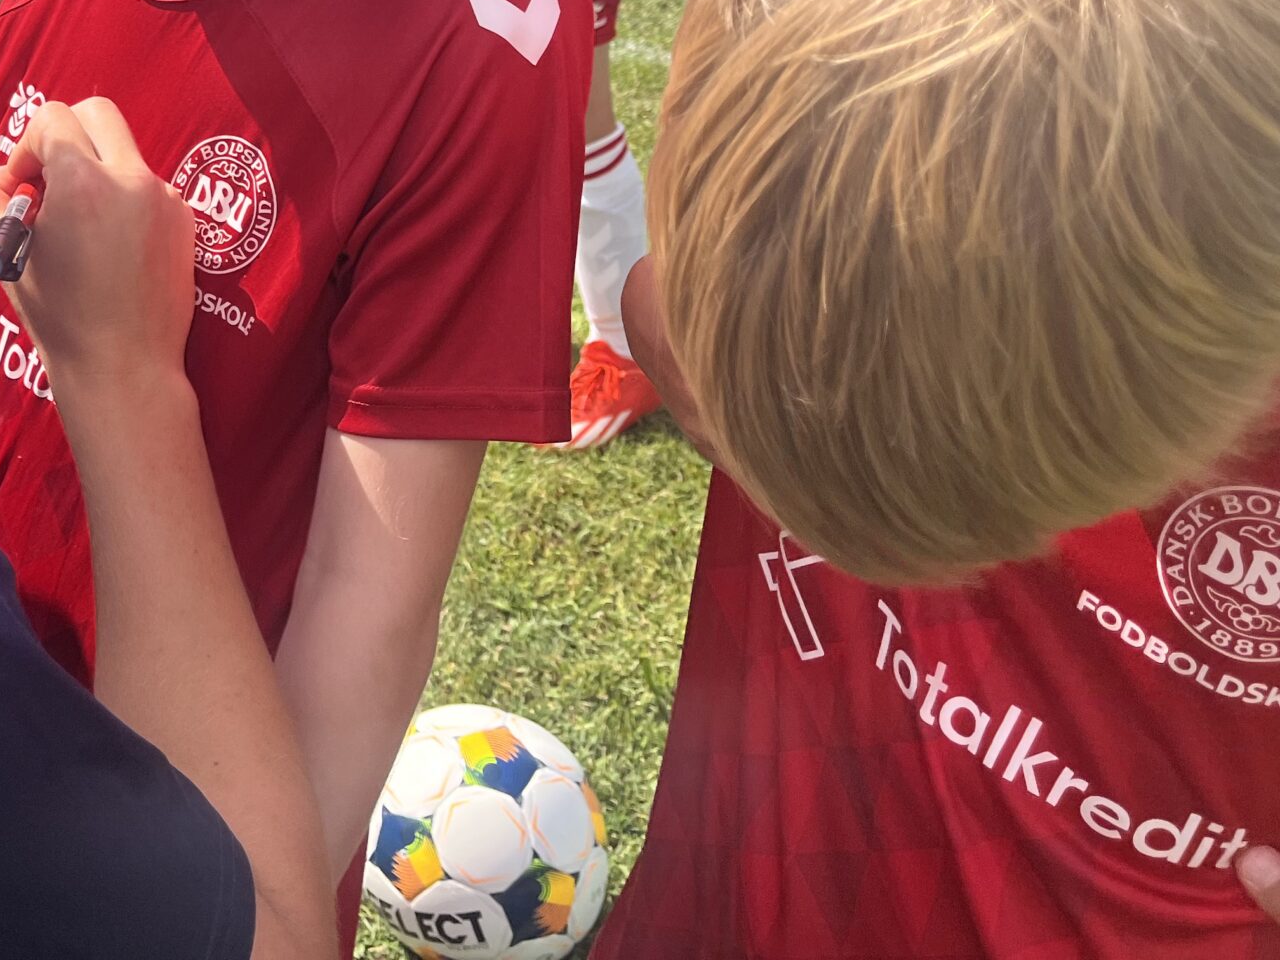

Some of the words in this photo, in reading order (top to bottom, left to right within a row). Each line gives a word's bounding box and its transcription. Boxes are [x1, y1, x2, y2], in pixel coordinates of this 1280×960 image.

[188, 173, 253, 233] DBU
[194, 246, 222, 269] 889
[1166, 503, 1214, 607] DANSK
[1221, 494, 1280, 520] BO
[1197, 531, 1280, 608] DB
[1192, 617, 1279, 657] 1889
[875, 599, 1249, 869] Totalkredit
